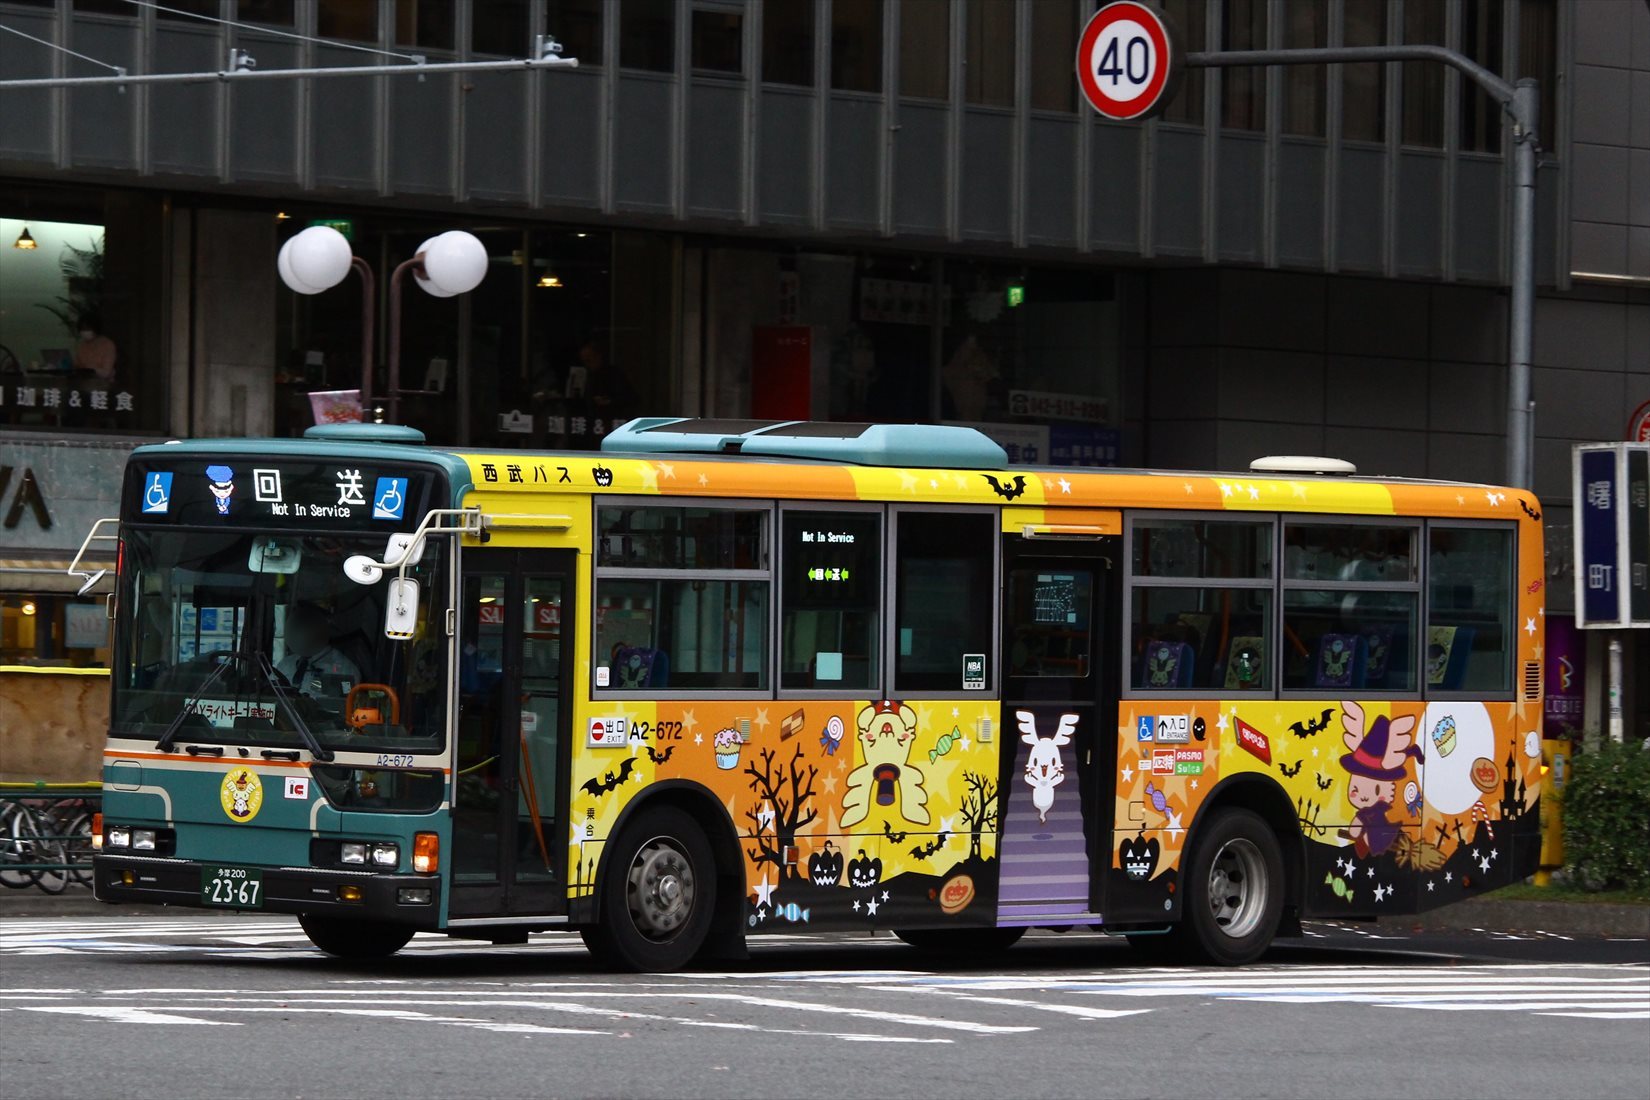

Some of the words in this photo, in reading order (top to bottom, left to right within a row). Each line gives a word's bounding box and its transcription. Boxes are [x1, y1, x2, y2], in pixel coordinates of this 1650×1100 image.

[1097, 36, 1149, 86] 40
[481, 463, 572, 484] 西武バス
[271, 503, 289, 516] Not
[295, 504, 307, 517] In
[310, 505, 351, 518] Service
[802, 530, 814, 543] Not
[817, 531, 826, 543] In
[827, 531, 855, 543] Service
[606, 720, 624, 733] 出口
[1170, 718, 1186, 730] 入口
[630, 721, 683, 741] A2-672
[607, 735, 622, 743] EXIT
[377, 755, 414, 767] A2-672
[1177, 751, 1202, 760] PASMO
[1177, 763, 1201, 773] Suica
[586, 807, 595, 837] 乗合
[212, 878, 260, 905] 23-67
